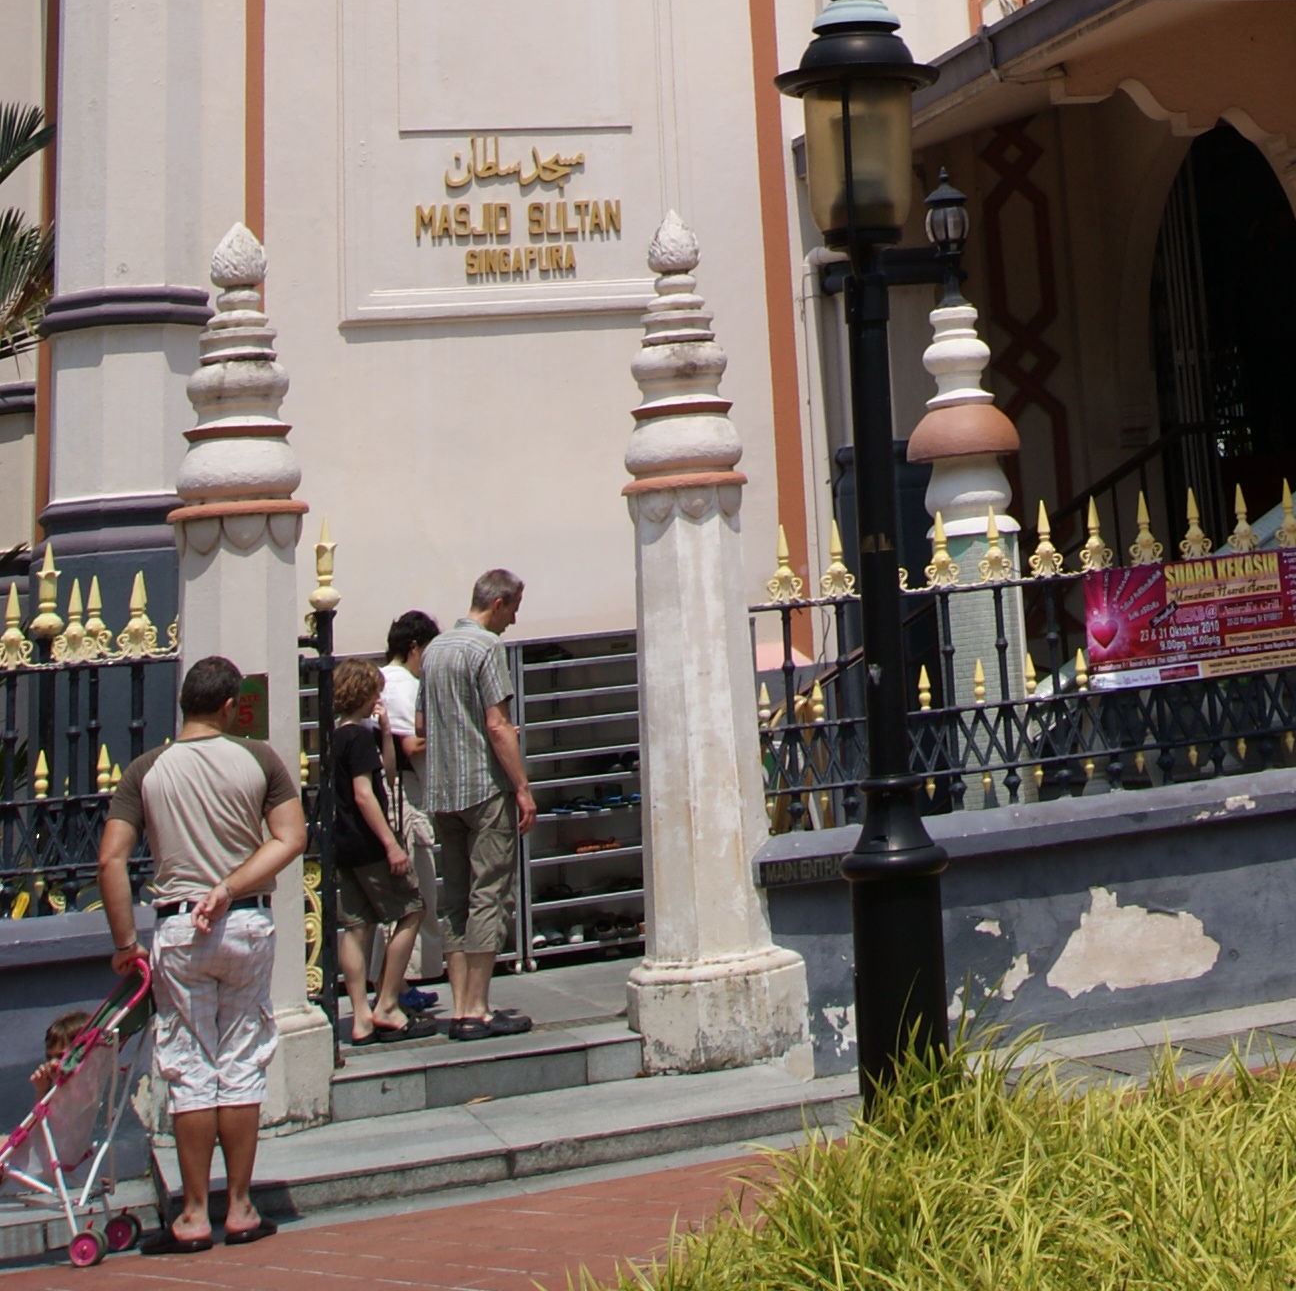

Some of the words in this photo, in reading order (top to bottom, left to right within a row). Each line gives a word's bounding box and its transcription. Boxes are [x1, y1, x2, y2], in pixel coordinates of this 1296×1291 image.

[415, 202, 511, 237] MASJID
[527, 199, 621, 235] SULTAN
[465, 244, 577, 276] SINGAPURA
[1164, 559, 1214, 589] SUARA
[1216, 552, 1279, 583] KEKASIH
[1140, 629, 1149, 642] 23
[1159, 627, 1167, 639] 31
[1169, 624, 1200, 638] Oktober
[1201, 621, 1220, 634] 2010
[239, 704, 255, 726] 5
[765, 862, 797, 882] MAIN
